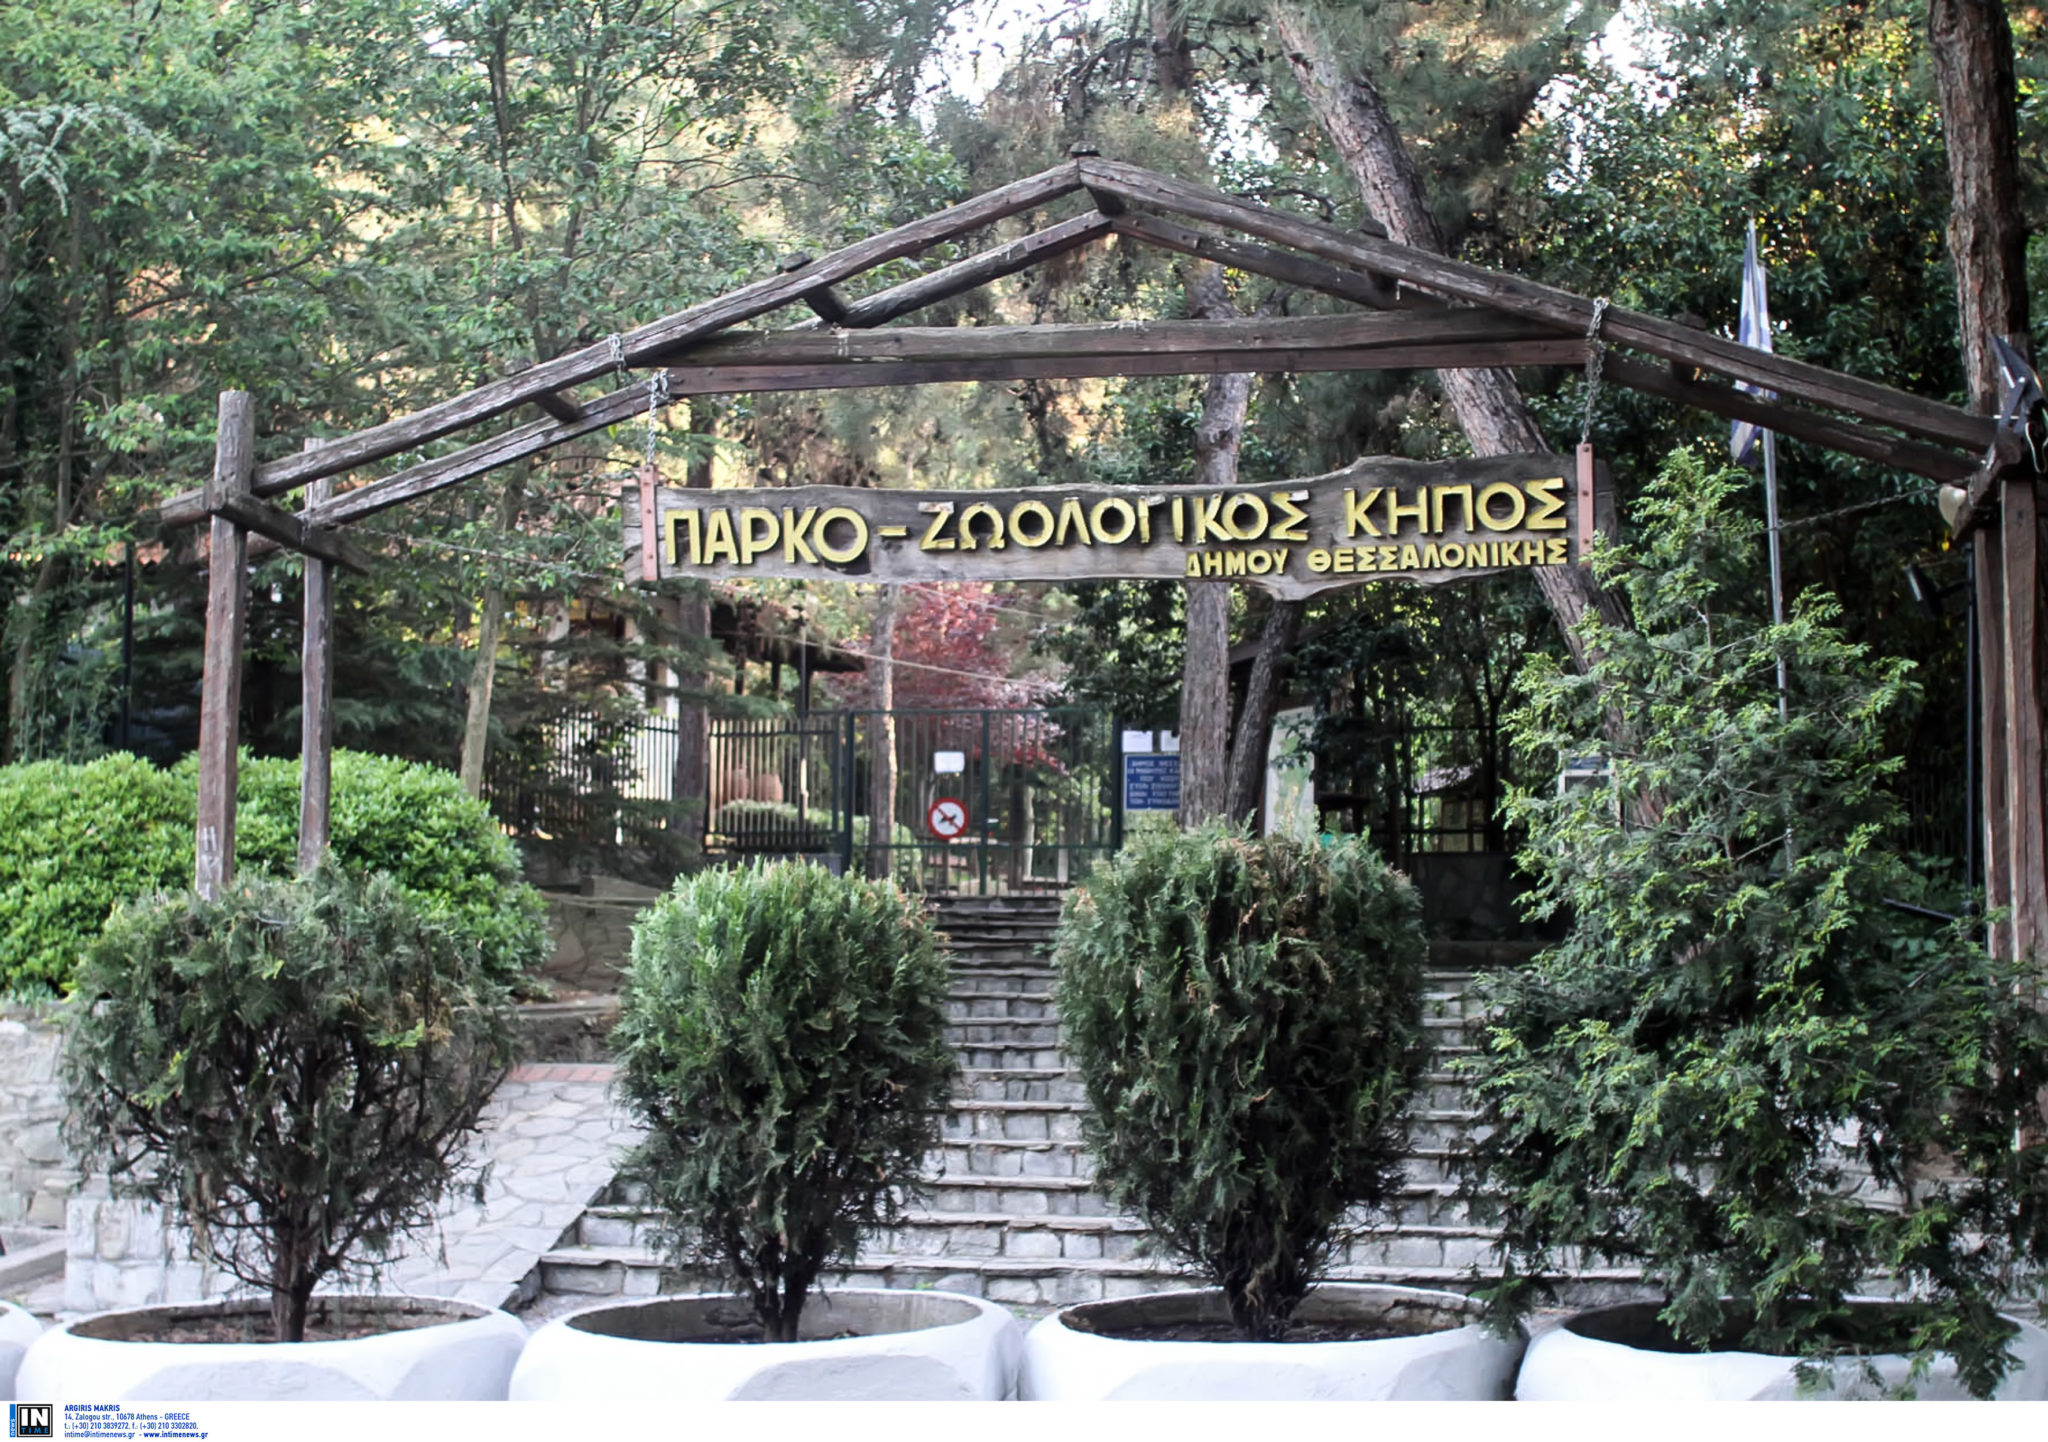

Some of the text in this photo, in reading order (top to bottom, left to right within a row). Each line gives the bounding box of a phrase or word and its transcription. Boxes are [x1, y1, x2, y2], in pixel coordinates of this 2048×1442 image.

[664, 506, 870, 564] ΠΑΡΚΟ
[918, 490, 1310, 551] ΖΩΟΛΟΓΙΚΟΣ
[1344, 477, 1567, 538] ΚΗΠΟΣ
[1186, 538, 1568, 578] ΔΗΜΟΥ ΘΕΣΣΑΛΟΝΙΚΗΣ
